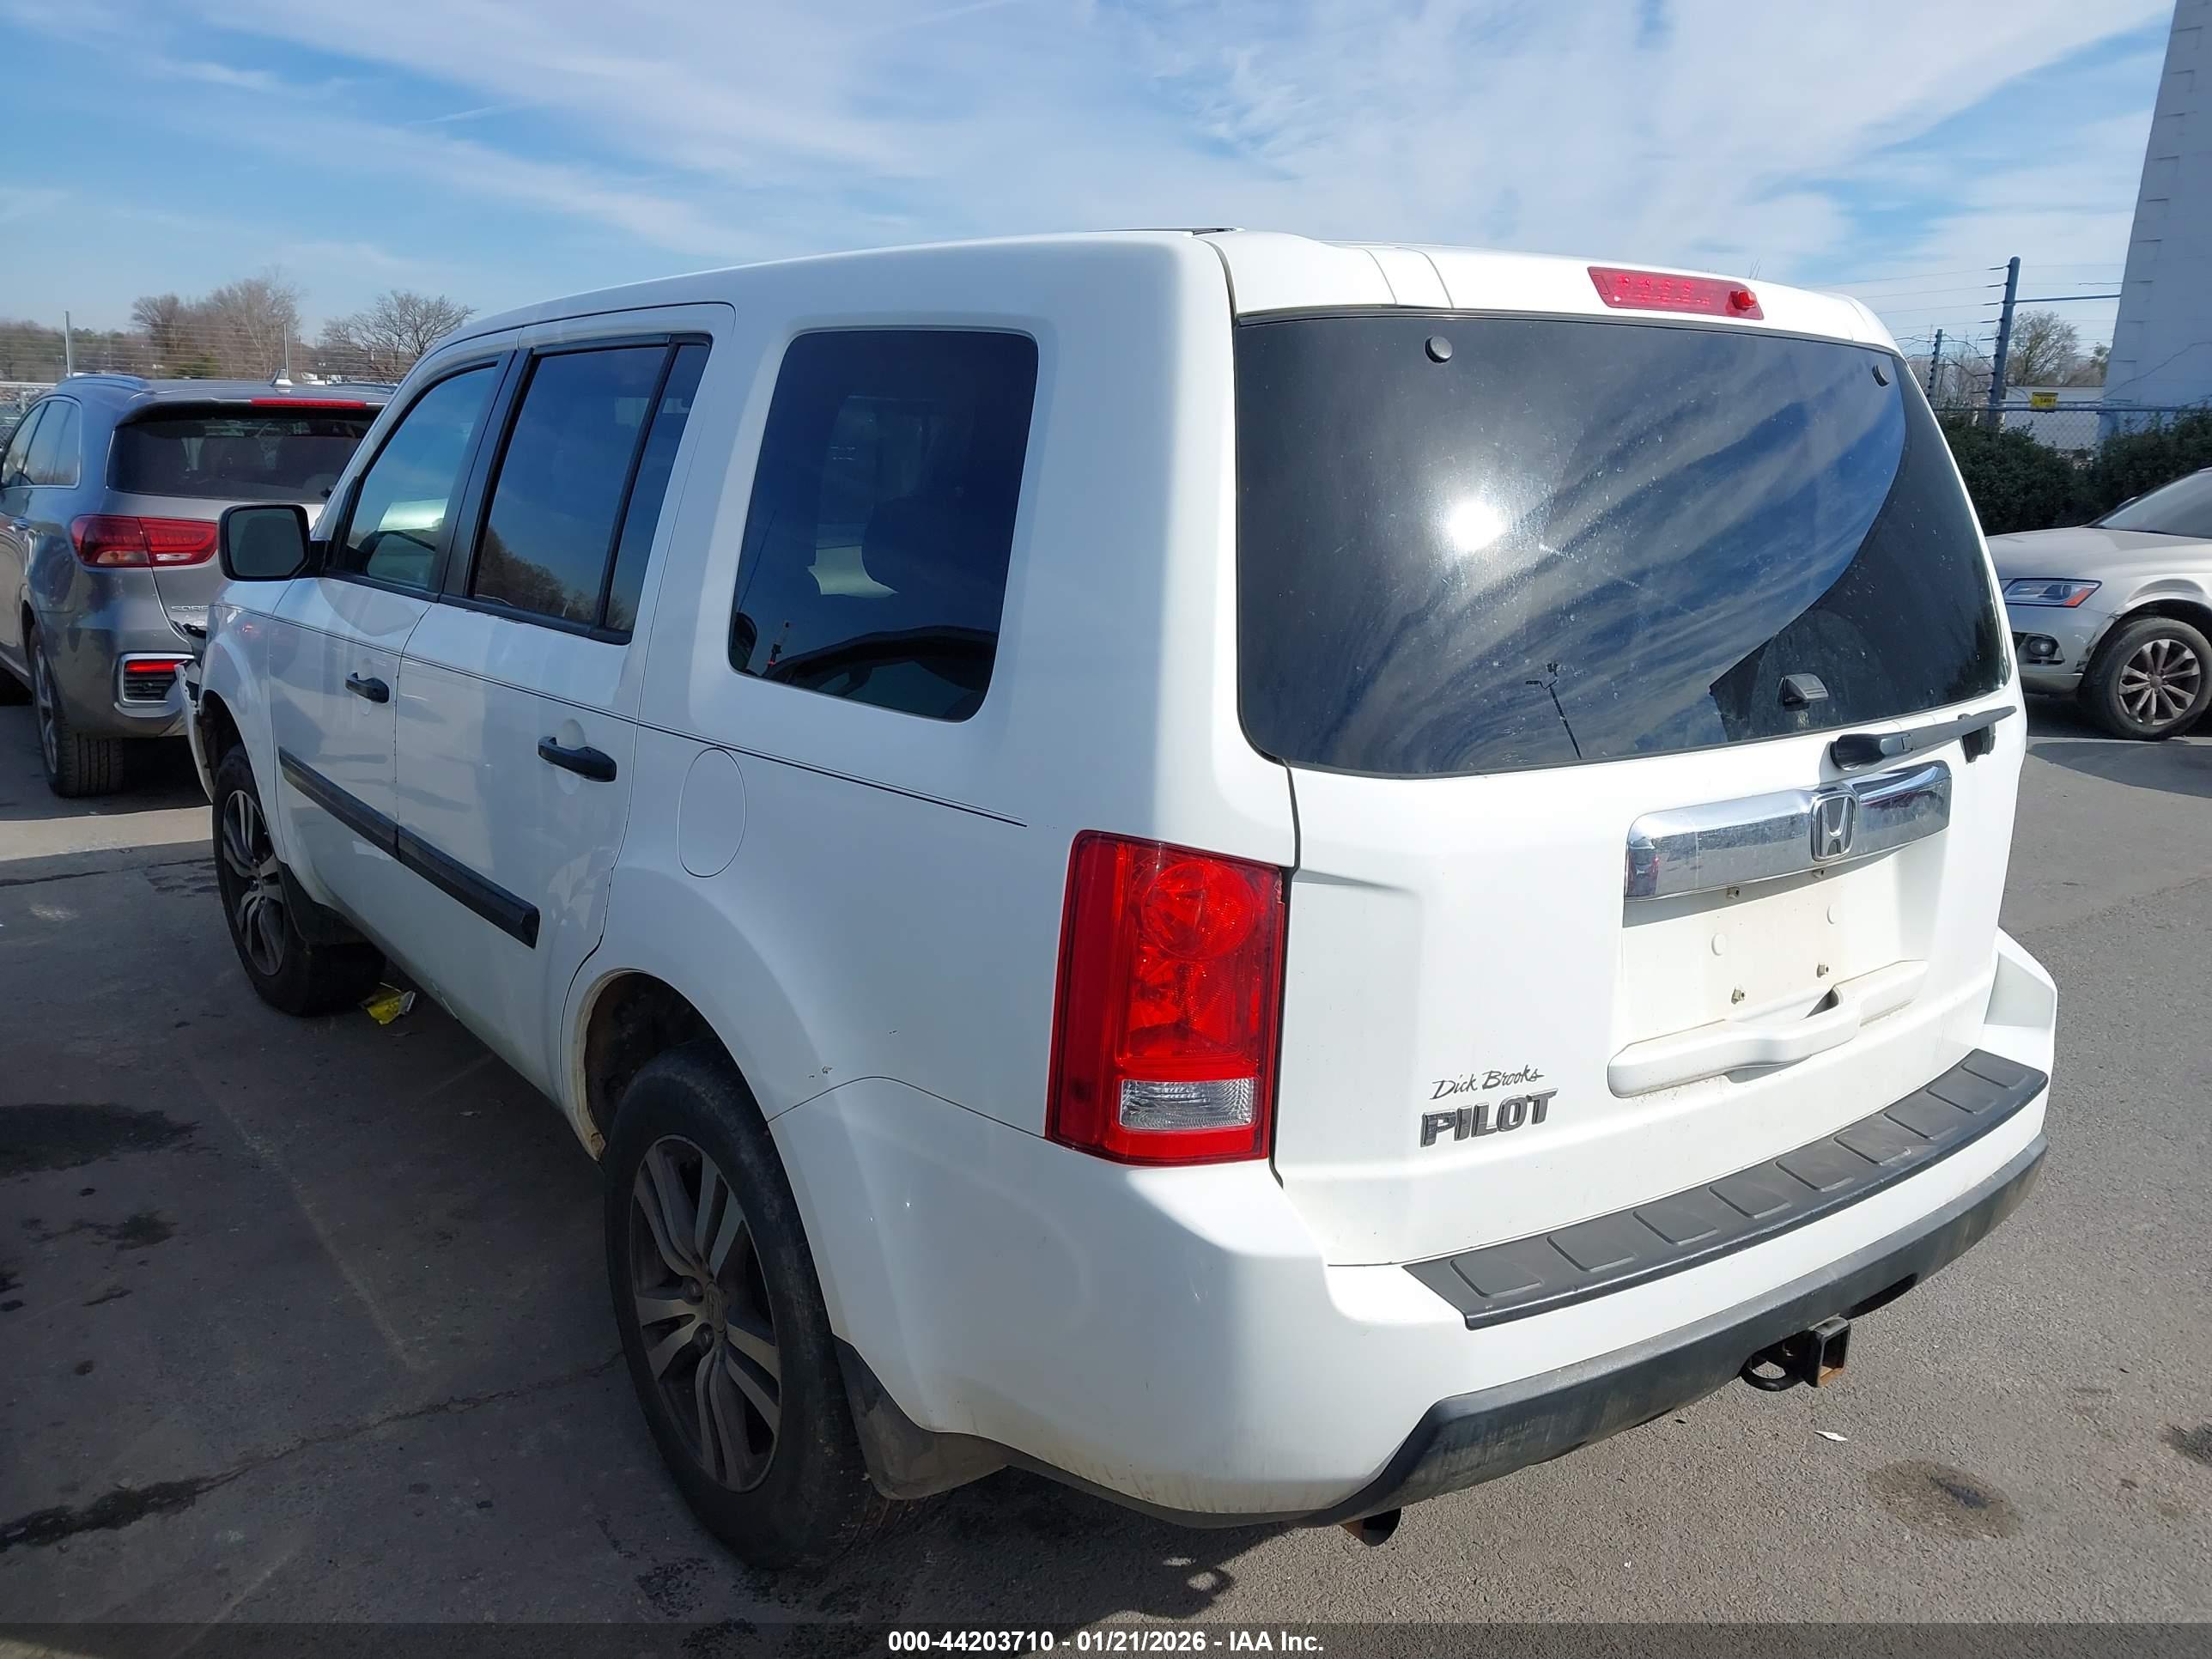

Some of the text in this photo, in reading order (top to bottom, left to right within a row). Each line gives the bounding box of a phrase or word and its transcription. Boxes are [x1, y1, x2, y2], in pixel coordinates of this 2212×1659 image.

[1430, 1065, 1545, 1099] Dick Brooks
[1420, 1088, 1559, 1147] PILOT
